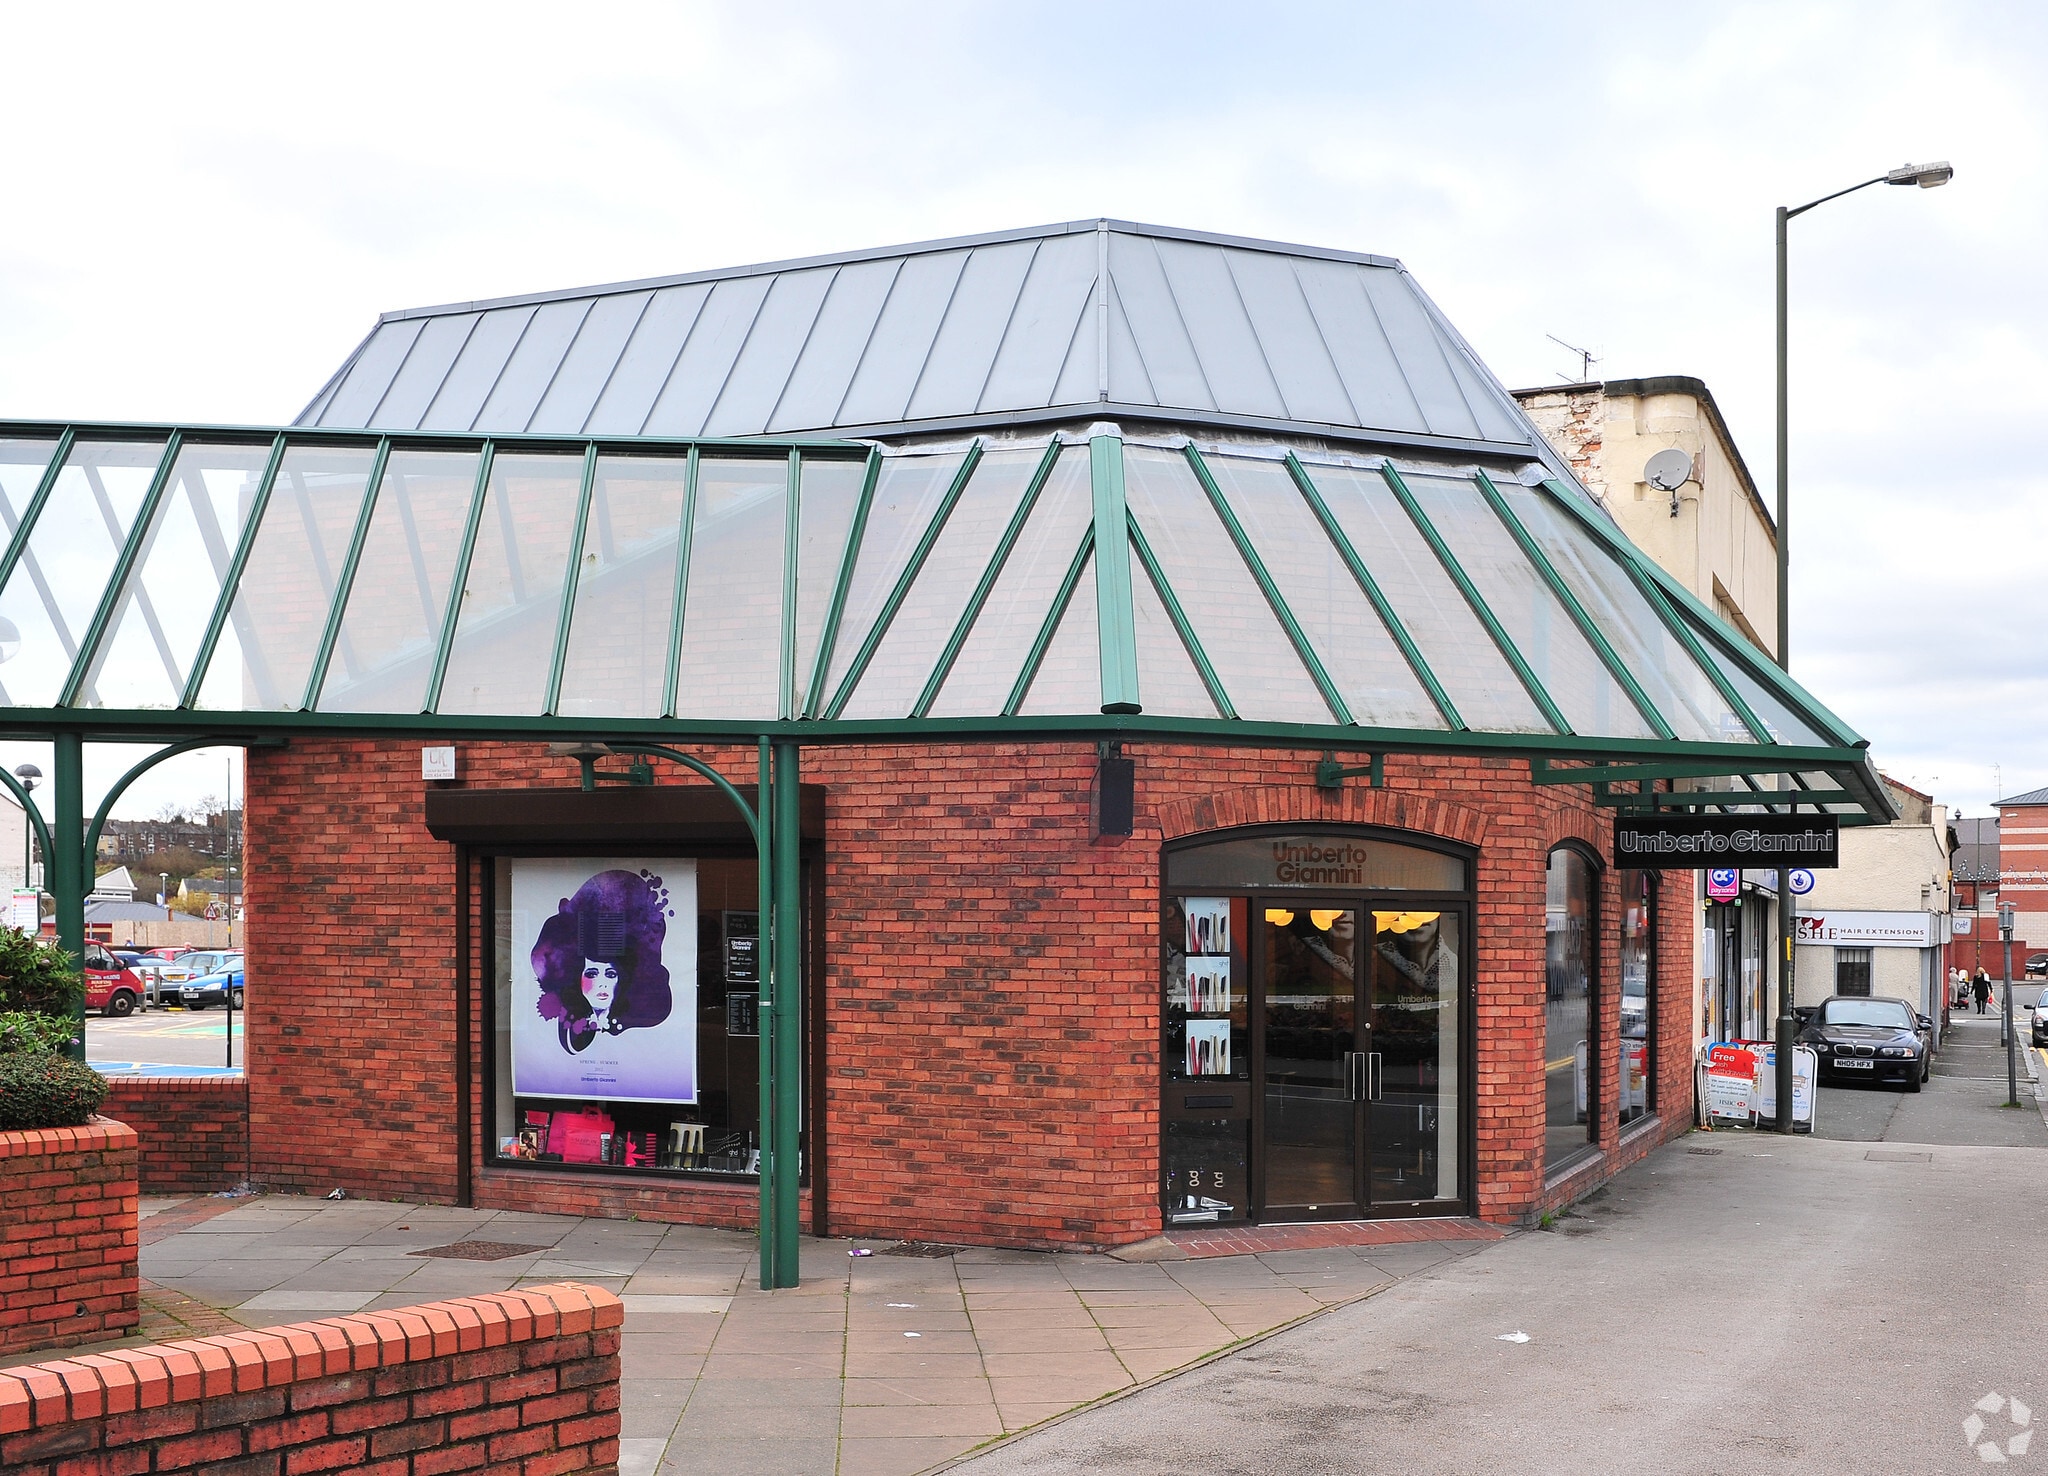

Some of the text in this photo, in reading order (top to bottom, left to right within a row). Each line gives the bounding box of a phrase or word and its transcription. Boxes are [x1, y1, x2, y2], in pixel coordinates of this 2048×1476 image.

[1619, 829, 1834, 853] Umberto Giannini
[1272, 841, 1367, 864] Umberto
[1276, 862, 1363, 884] Giannini
[1710, 887, 1736, 895] payzone
[1397, 994, 1433, 1003] Umberto
[1713, 1051, 1736, 1063] Free
